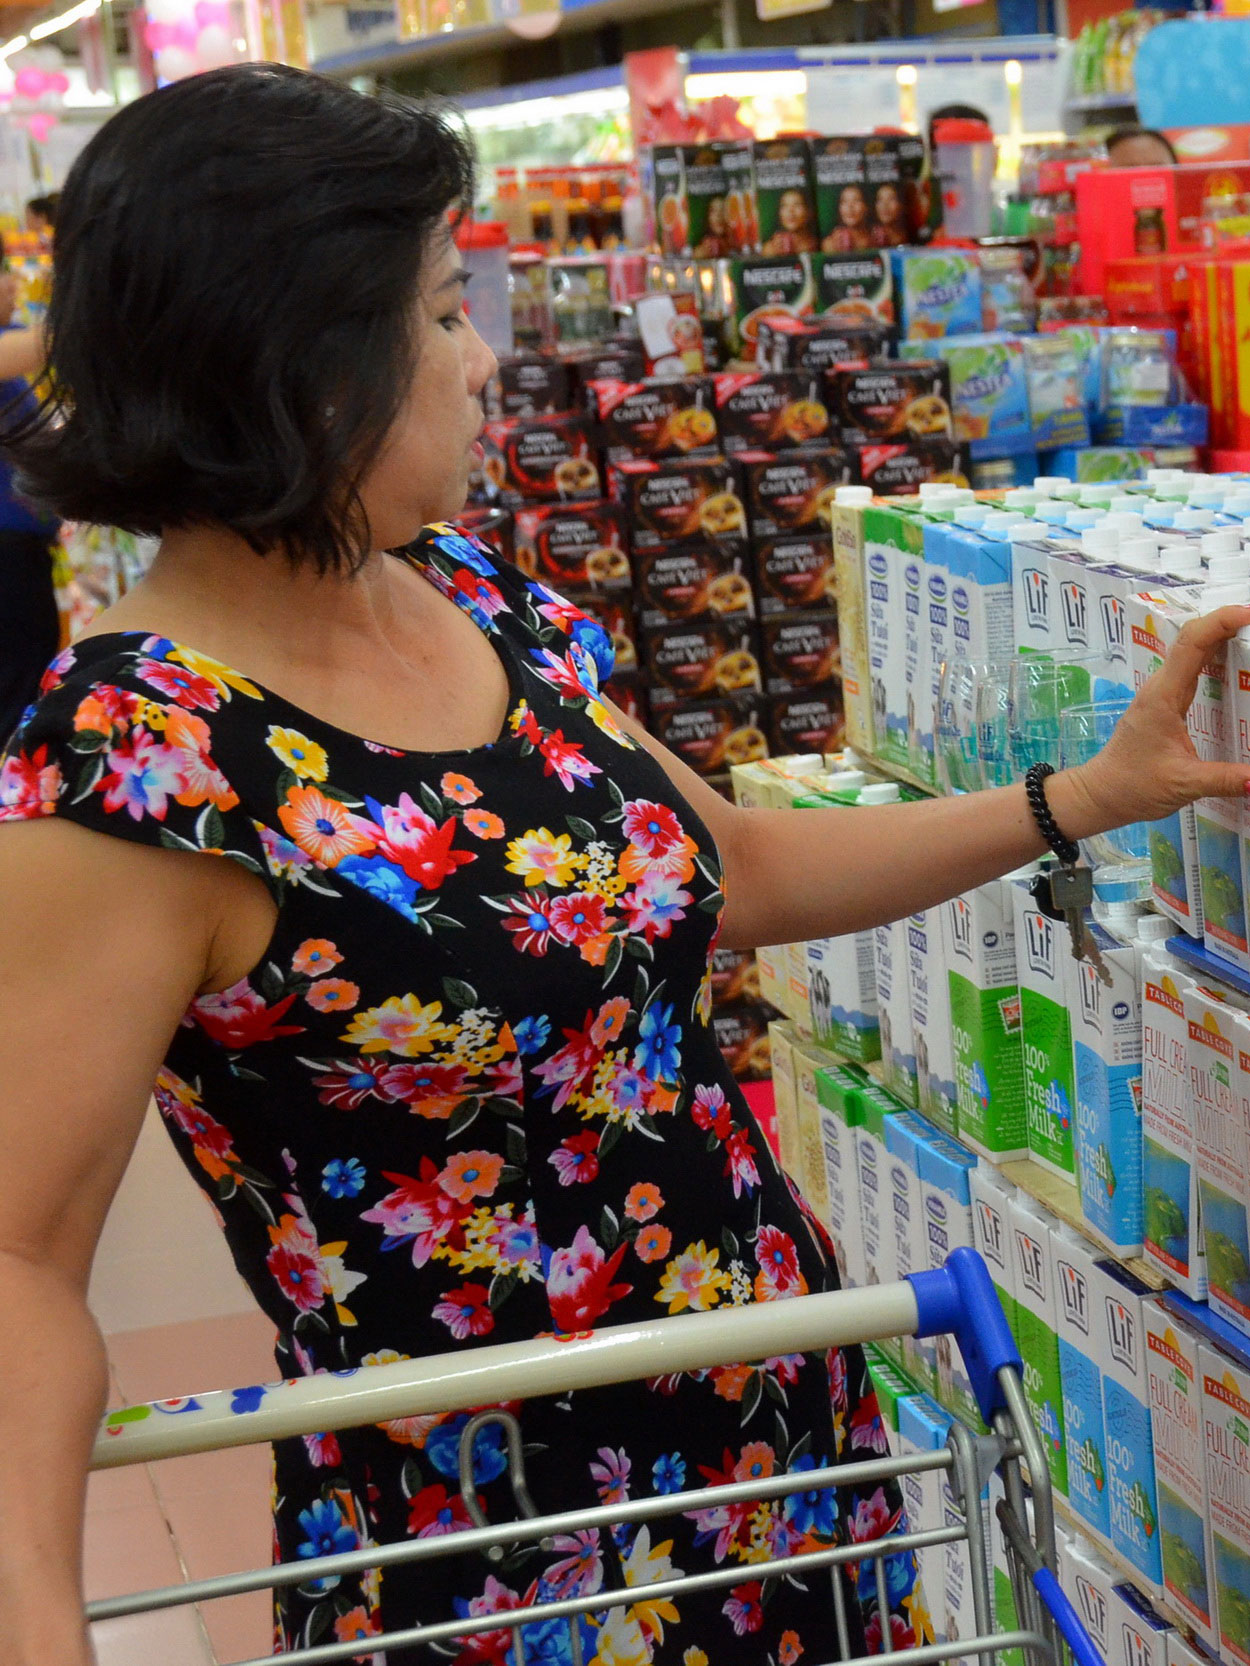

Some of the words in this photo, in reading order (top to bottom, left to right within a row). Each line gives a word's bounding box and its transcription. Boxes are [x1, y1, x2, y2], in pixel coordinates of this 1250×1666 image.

[1134, 630, 1155, 648] TABLE
[1028, 915, 1053, 967] LiF
[1149, 986, 1174, 1008] TABLE
[1144, 1026, 1167, 1064] FULL
[1191, 1025, 1213, 1047] TABLE
[1214, 1037, 1234, 1060] COVE
[955, 1050, 981, 1092] Fresh
[1026, 1067, 1062, 1115] Fresh
[1190, 1065, 1213, 1104] FULL
[1028, 1101, 1058, 1142] Milk
[1080, 1130, 1108, 1180] Fresh
[1082, 1159, 1104, 1207] Milk
[1018, 1237, 1042, 1283] LiF
[1060, 1267, 1086, 1316] LiF
[1108, 1304, 1134, 1356] LiF
[1149, 1336, 1175, 1360] TABLE
[1175, 1351, 1193, 1376] COVE
[1150, 1374, 1171, 1413] FULL
[1206, 1380, 1233, 1403] TABLE
[1206, 1421, 1229, 1460] FULL
[1108, 1461, 1145, 1519] Fresh
[1110, 1498, 1142, 1546] Milk
[1081, 1581, 1106, 1633] LiF
